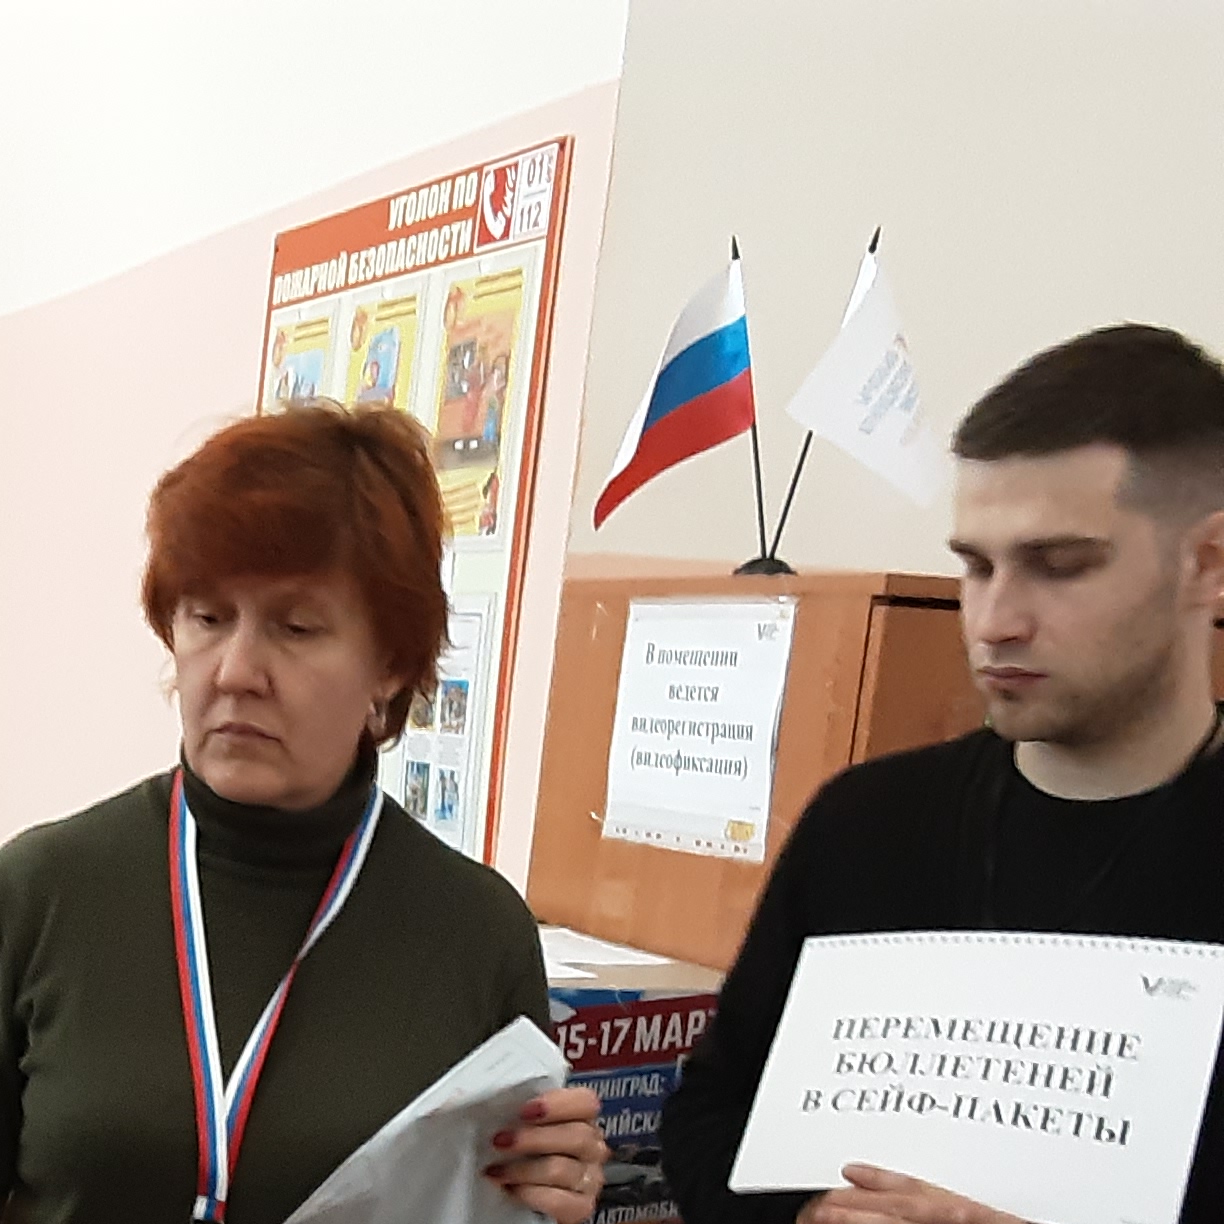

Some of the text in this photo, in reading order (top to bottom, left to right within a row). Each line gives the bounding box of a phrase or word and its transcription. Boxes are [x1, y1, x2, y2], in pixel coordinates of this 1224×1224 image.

[452, 171, 479, 211] ПО
[519, 200, 542, 232] 112
[272, 250, 349, 306] ПОЖАРНОЙ
[348, 217, 474, 285] БЕЗОПАСНОСТИ
[645, 642, 738, 668] В помещении
[668, 684, 720, 702] ведется
[631, 716, 753, 745] видеорегистрация
[630, 744, 748, 782] (видеофиксация)
[557, 1008, 718, 1060] 15-17 МАР
[832, 1017, 1142, 1061] ПЕРЕМЕЩЕНИЕ
[834, 1051, 1115, 1099] БЮЛЛЕТЕНЕЙ
[801, 1083, 1131, 1146] В СЕЙФ-ПАКЕТЫ
